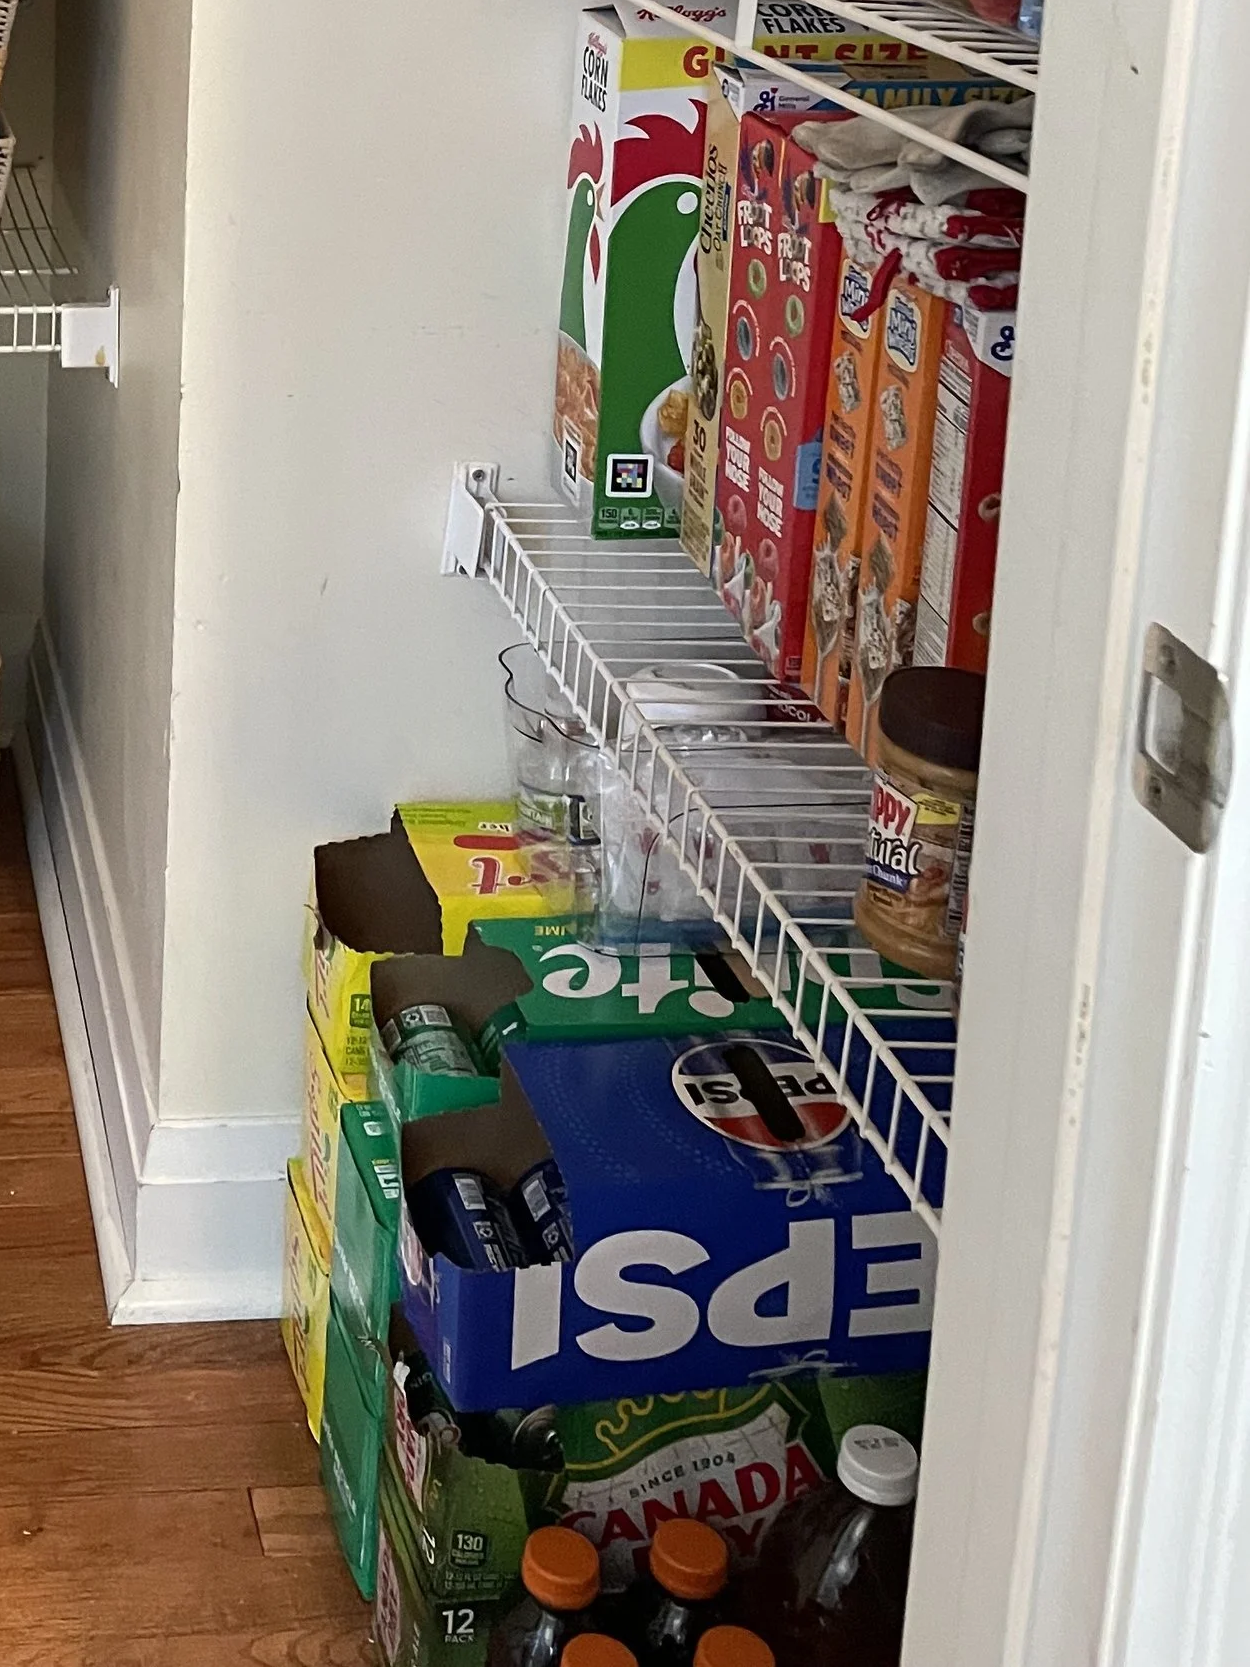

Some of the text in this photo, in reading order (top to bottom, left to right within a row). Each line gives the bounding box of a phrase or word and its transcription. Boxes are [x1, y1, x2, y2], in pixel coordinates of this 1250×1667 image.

[636, 3, 728, 23] Klogg's
[761, 17, 846, 34] FLAKES
[583, 46, 608, 88] CORN
[683, 44, 819, 79] GINT
[581, 74, 607, 112] FLAKES
[700, 143, 719, 254] Cheerios
[714, 161, 728, 220] CRUNCH
[601, 508, 618, 519] 150
[683, 1072, 838, 1107] PESI
[559, 1441, 825, 1550] CANADA
[628, 1464, 686, 1499] SINCE
[456, 1534, 484, 1552] 130
[442, 1608, 475, 1635] 12
[444, 1634, 476, 1644] PACK
